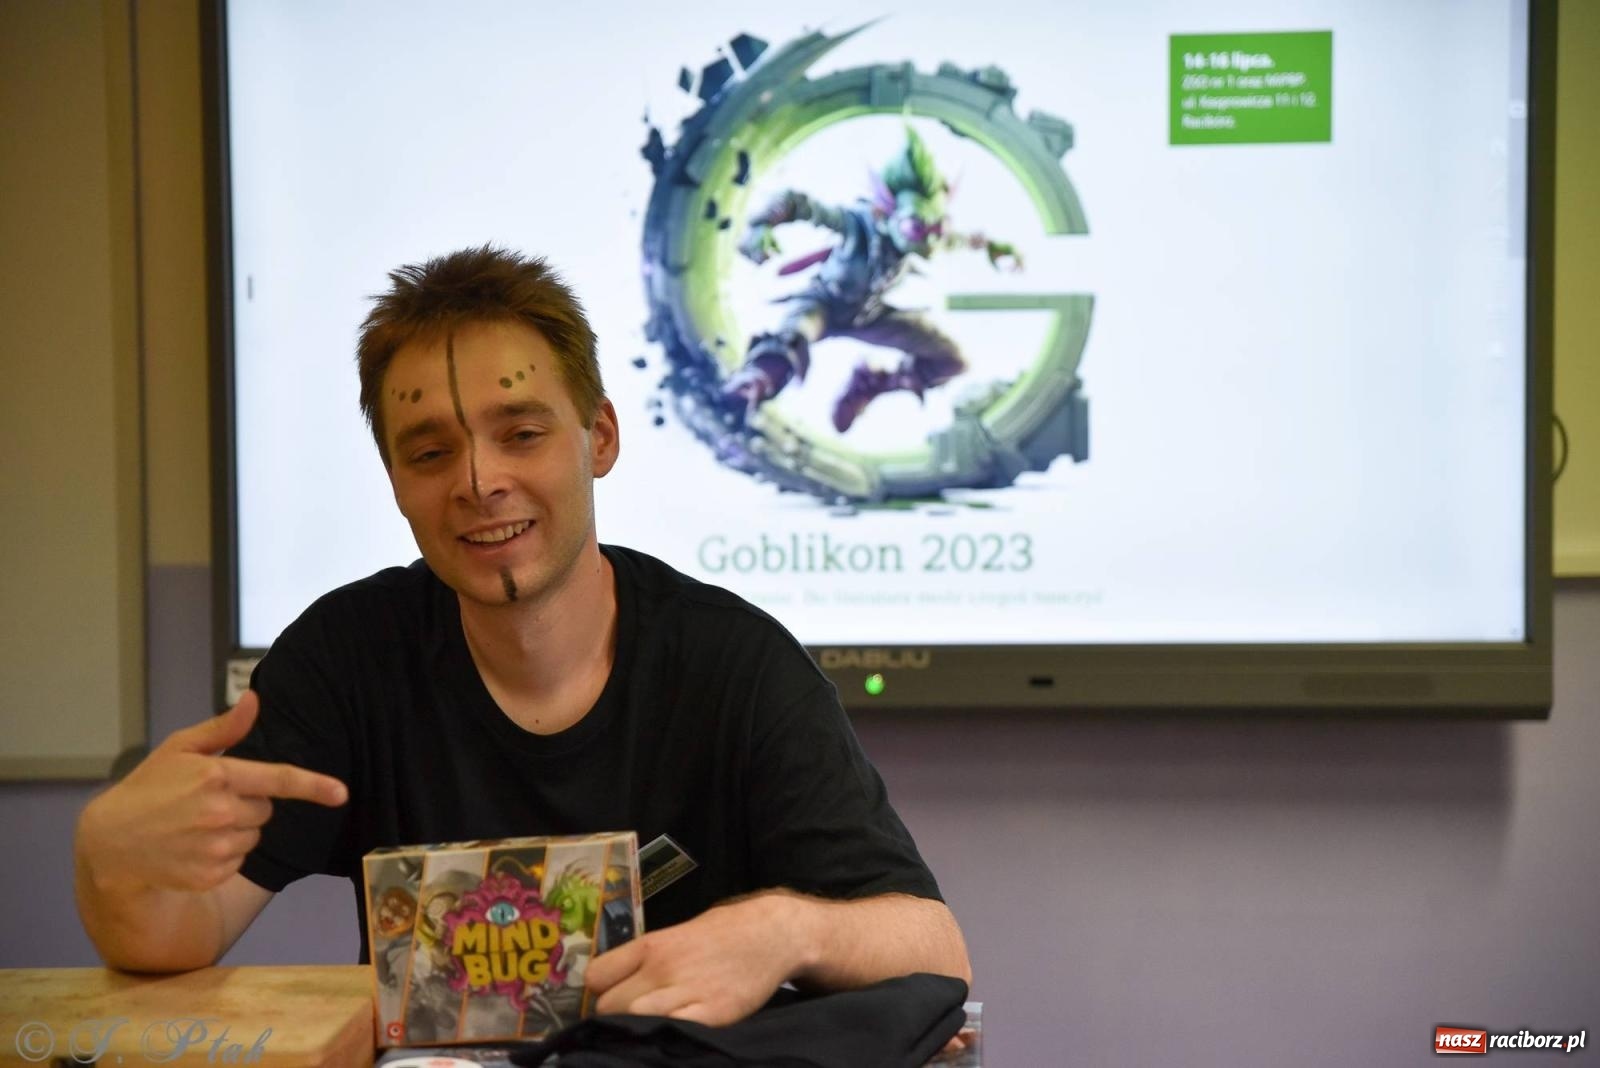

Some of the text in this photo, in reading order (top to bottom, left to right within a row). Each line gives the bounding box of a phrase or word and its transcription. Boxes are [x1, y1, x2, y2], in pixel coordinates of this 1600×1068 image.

[698, 532, 1035, 575] Goblikon 2023
[452, 918, 560, 956] MIND
[463, 949, 550, 988] BUG
